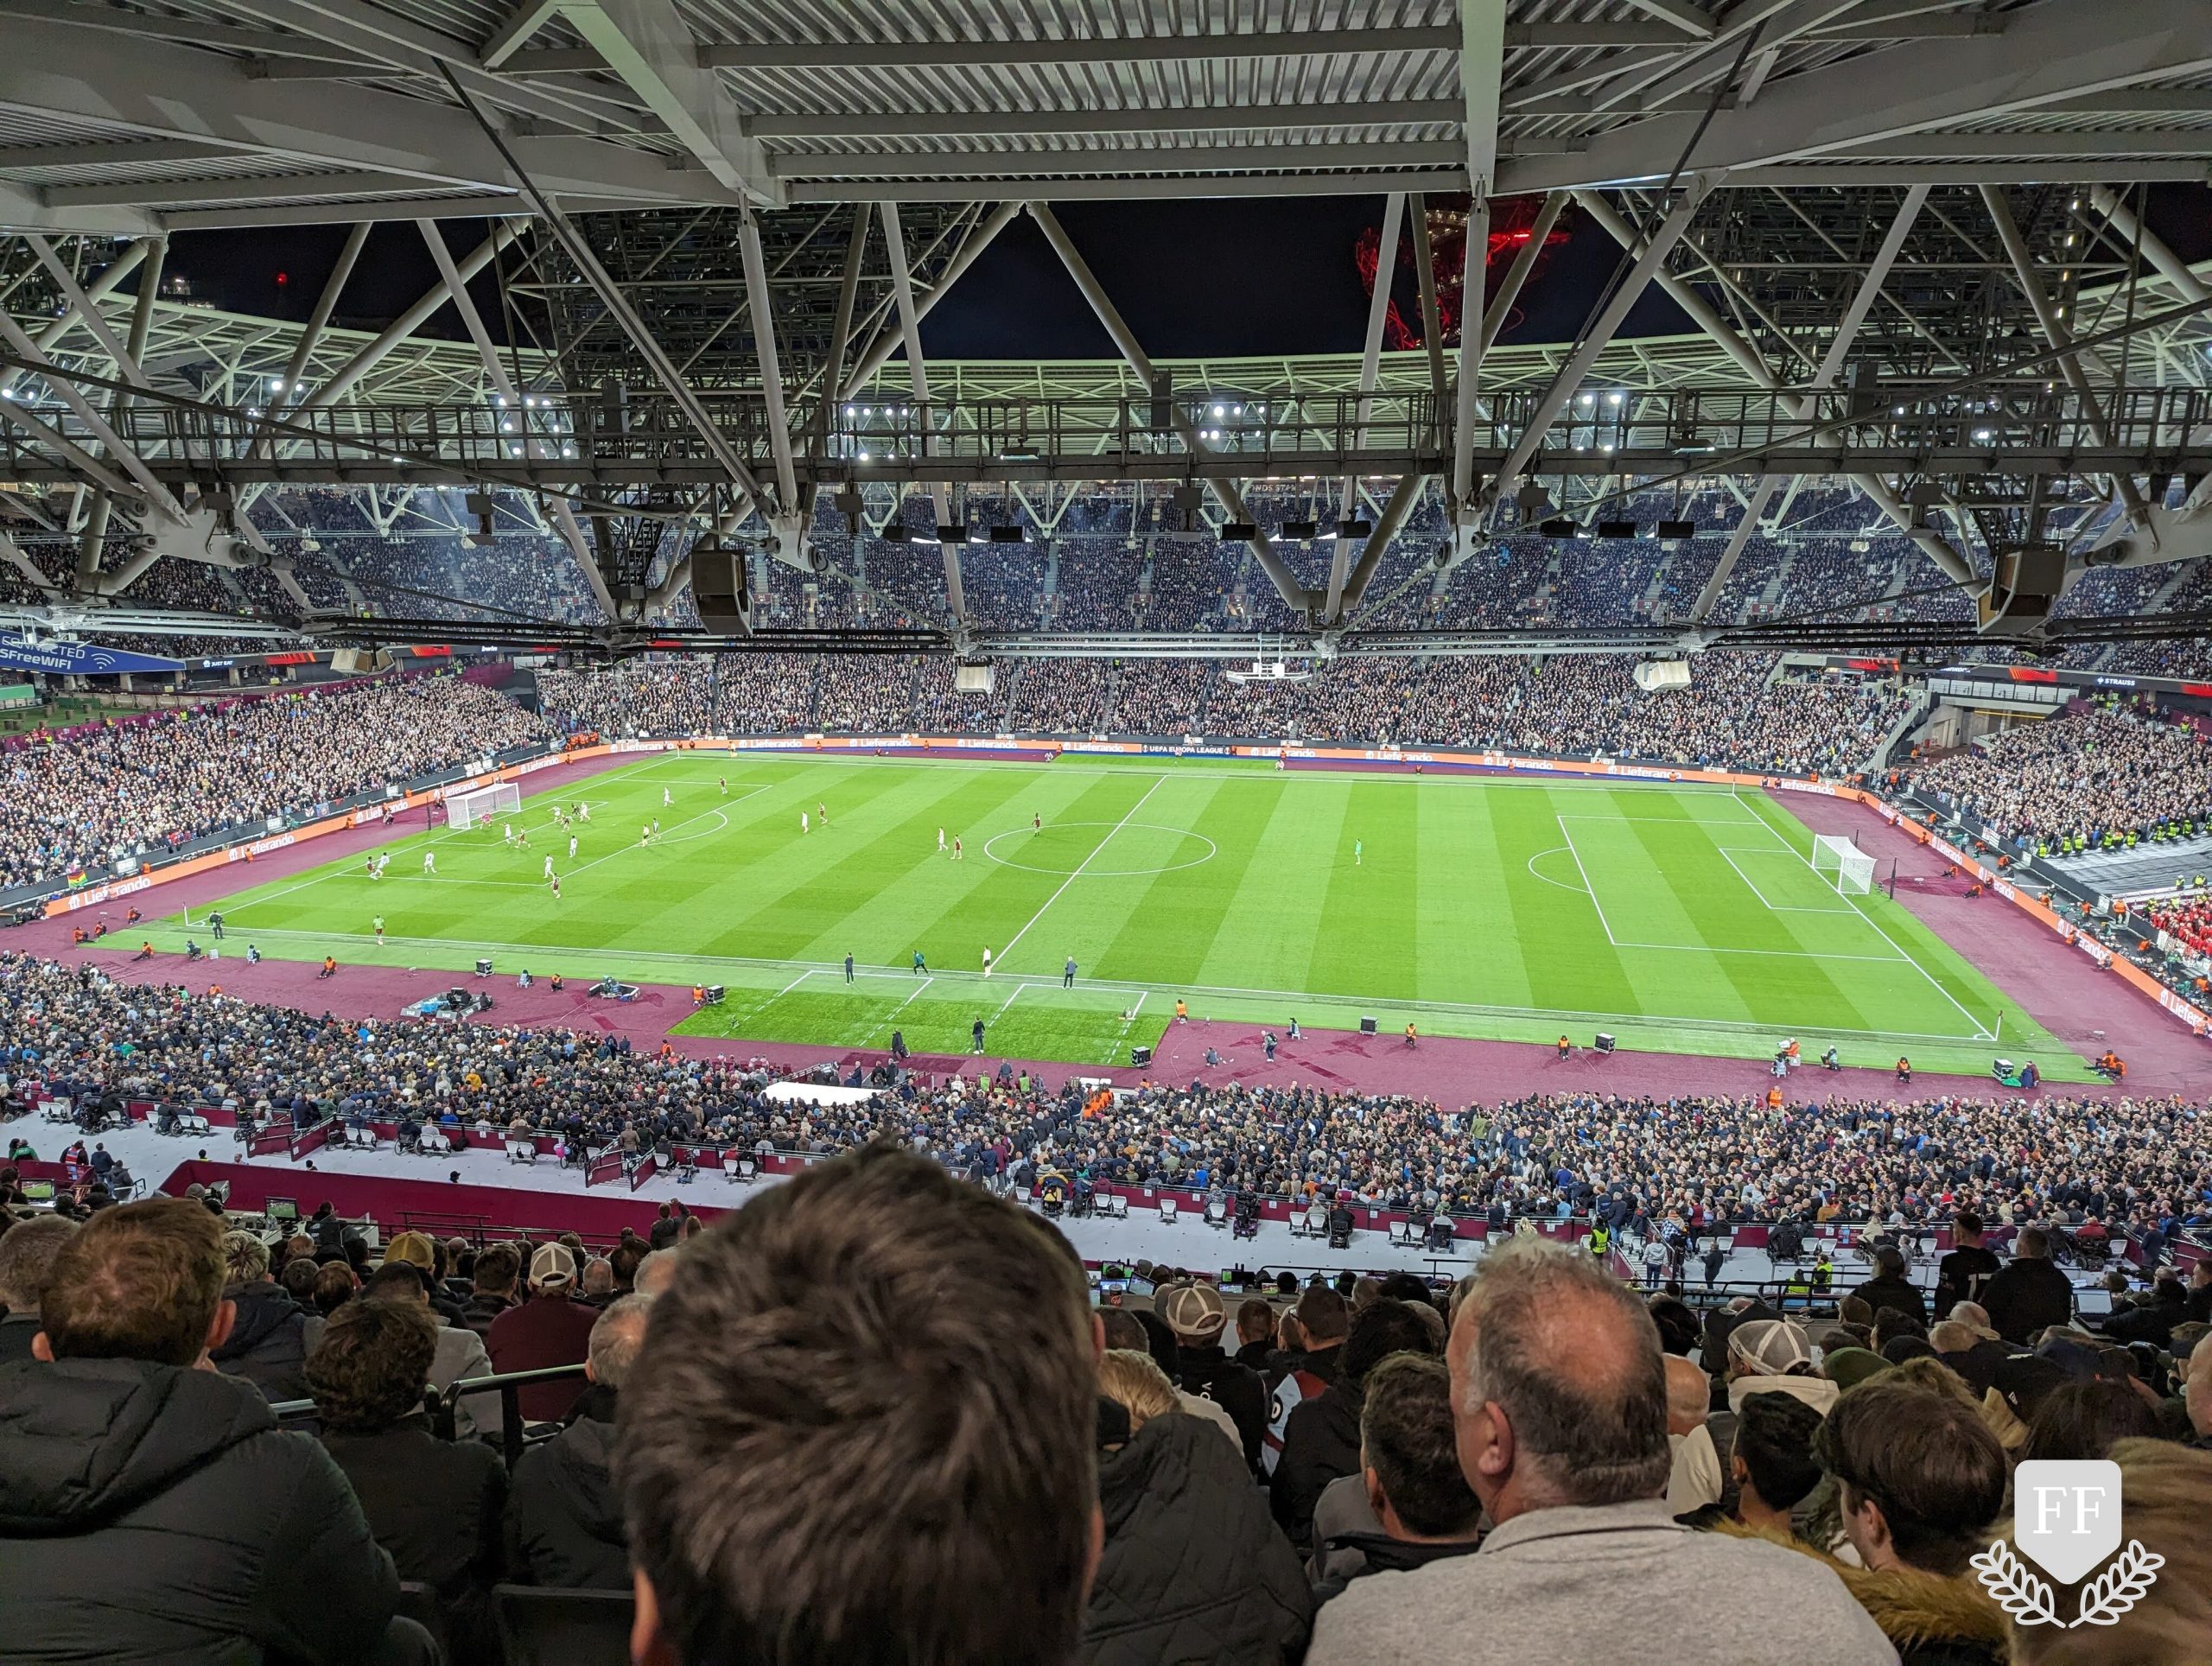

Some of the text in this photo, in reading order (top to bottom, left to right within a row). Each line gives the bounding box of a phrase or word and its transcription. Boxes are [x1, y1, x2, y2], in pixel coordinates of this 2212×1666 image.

[2, 636, 85, 658] COTED
[621, 741, 674, 753] Lieferano
[1262, 747, 1316, 758] Liefrando
[1621, 766, 1682, 779] Lieferano
[1777, 779, 1835, 795] ieferando
[365, 800, 409, 821] Liefando
[241, 832, 295, 858] Leferando
[84, 876, 151, 906] Liefrando
